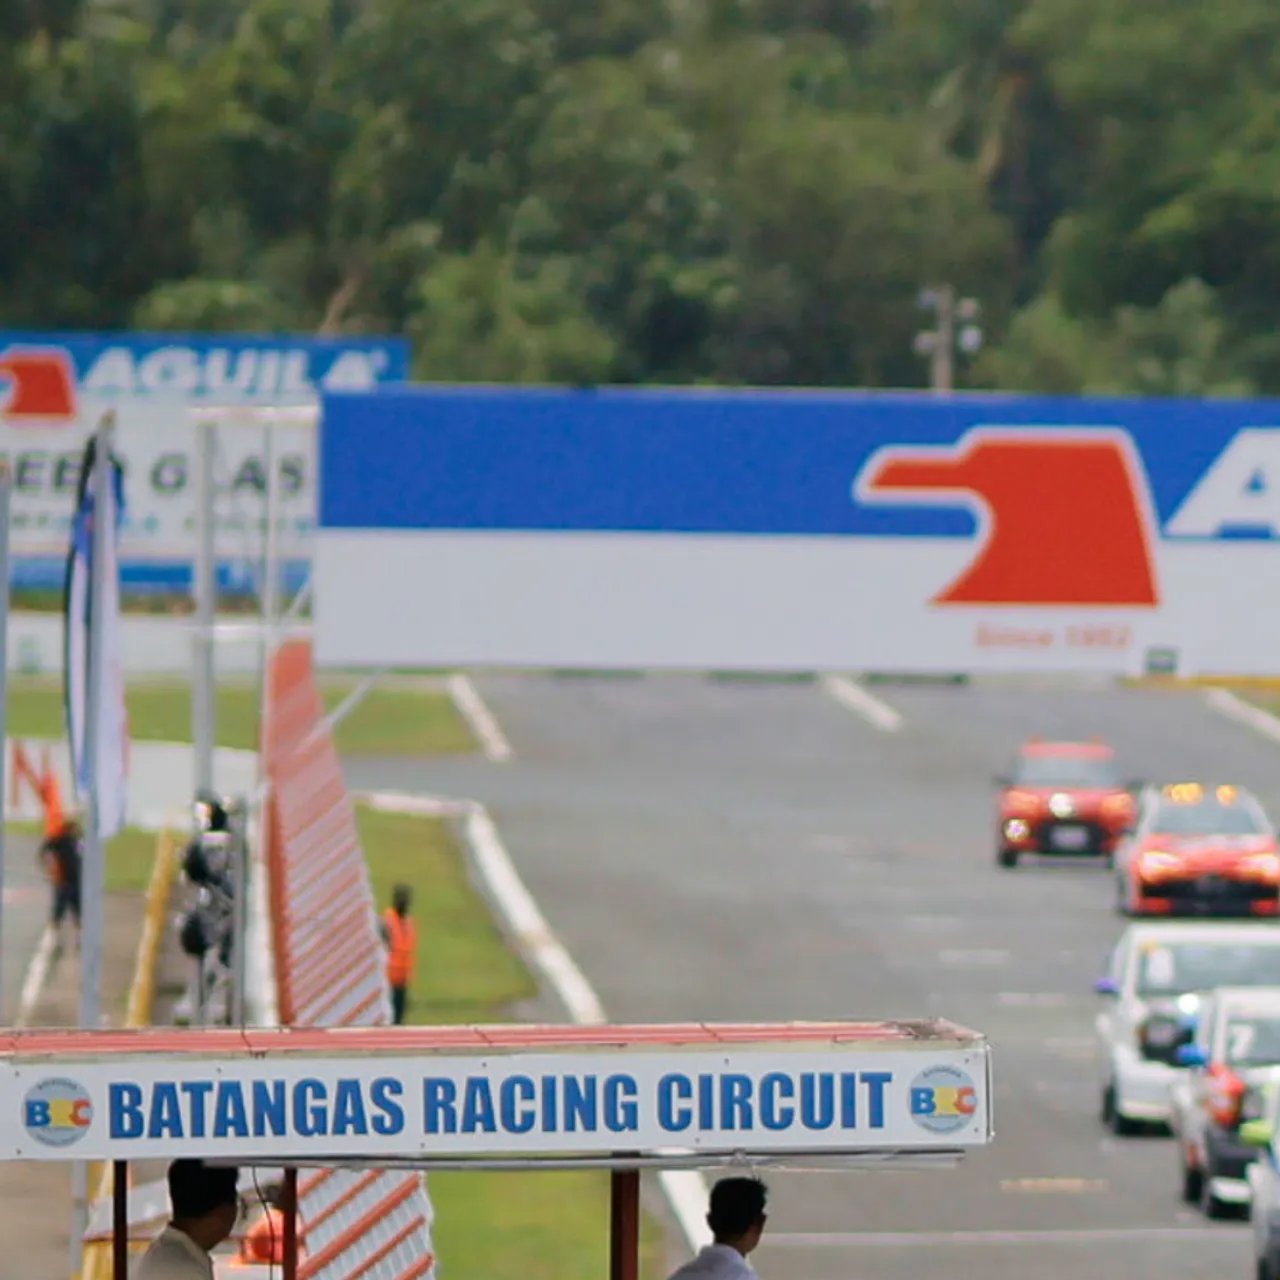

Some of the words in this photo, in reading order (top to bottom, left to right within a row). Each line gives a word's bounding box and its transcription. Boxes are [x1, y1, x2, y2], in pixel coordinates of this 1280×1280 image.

[80, 346, 368, 394] AGUILA
[108, 1076, 405, 1140] BATANGAS
[423, 1073, 639, 1135] RACING
[656, 1070, 893, 1133] CIRCUIT
